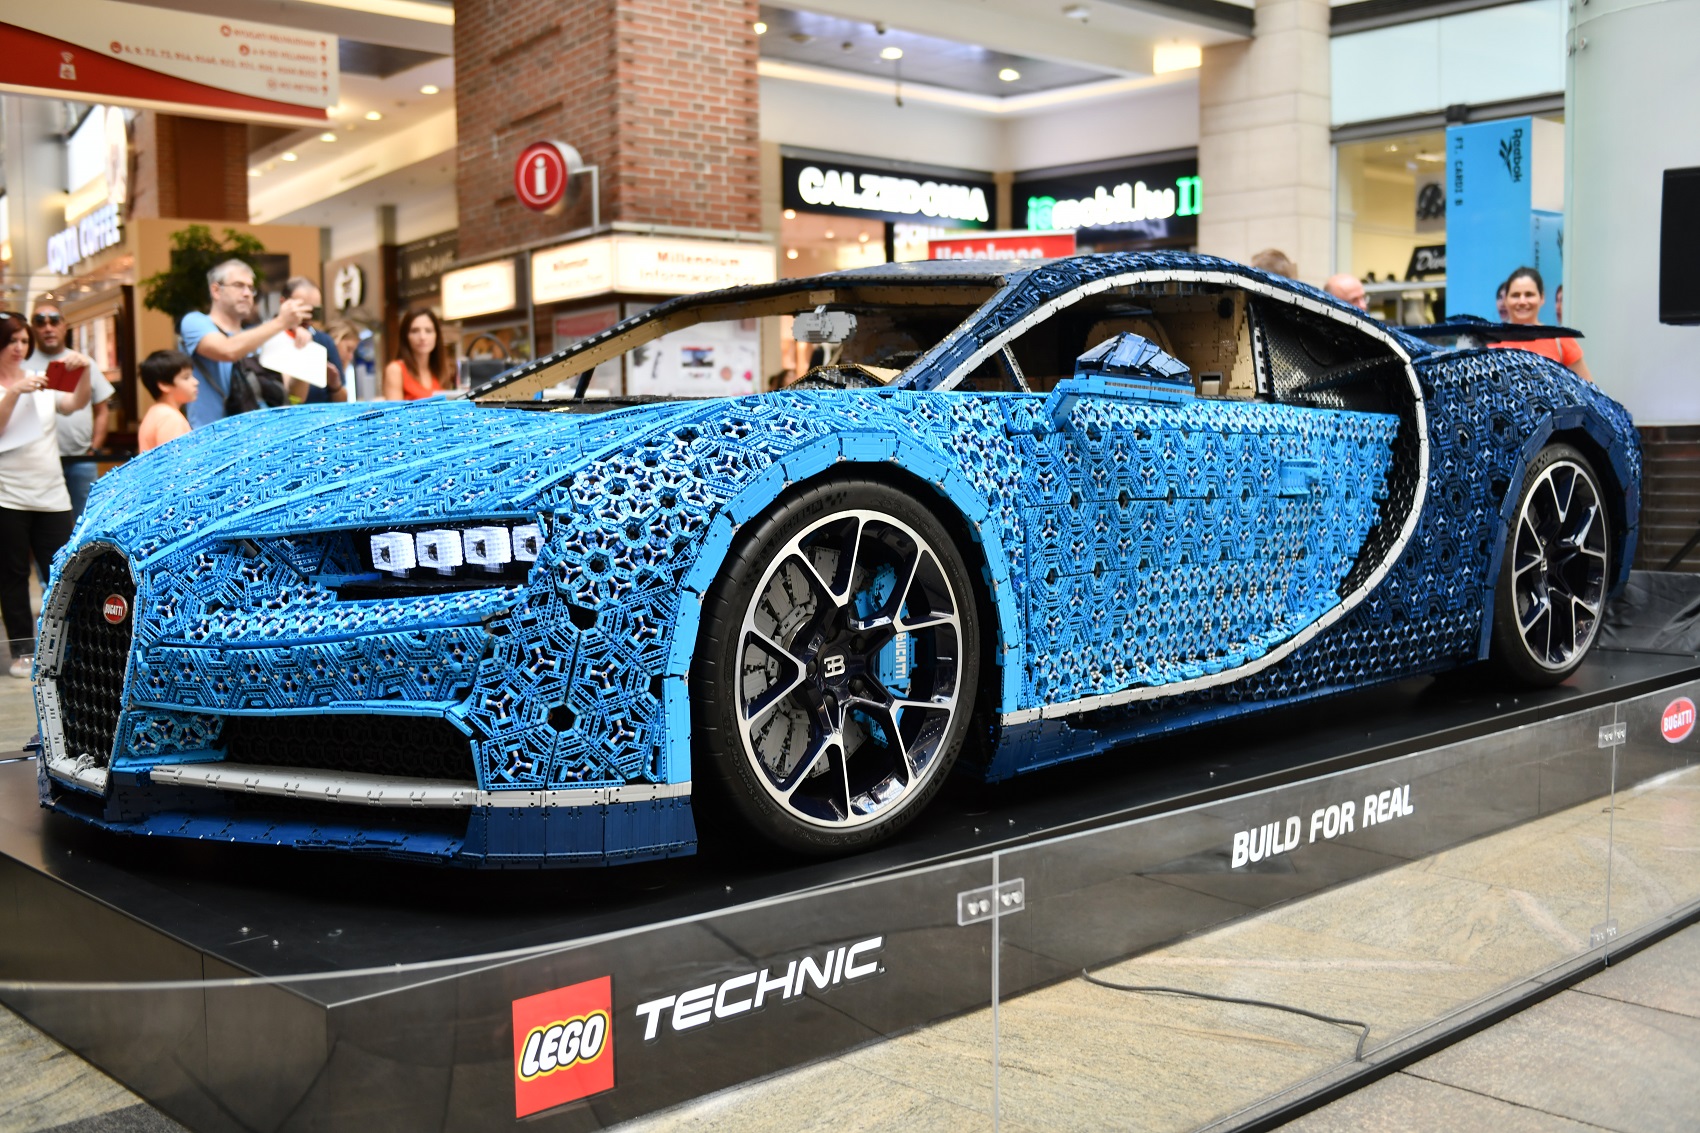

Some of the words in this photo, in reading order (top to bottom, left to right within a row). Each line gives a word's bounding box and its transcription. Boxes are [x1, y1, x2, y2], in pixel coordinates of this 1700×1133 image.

[1454, 160, 1464, 194] CARDI
[1512, 128, 1523, 183] Reebok
[657, 251, 740, 266] Millennium
[1663, 709, 1692, 733] BUGATTI
[1231, 815, 1301, 869] BUILD
[1309, 800, 1356, 844] FOR
[1362, 784, 1414, 829] REAL
[521, 1012, 607, 1078] LEGO
[635, 936, 883, 1041] TECHNIC
